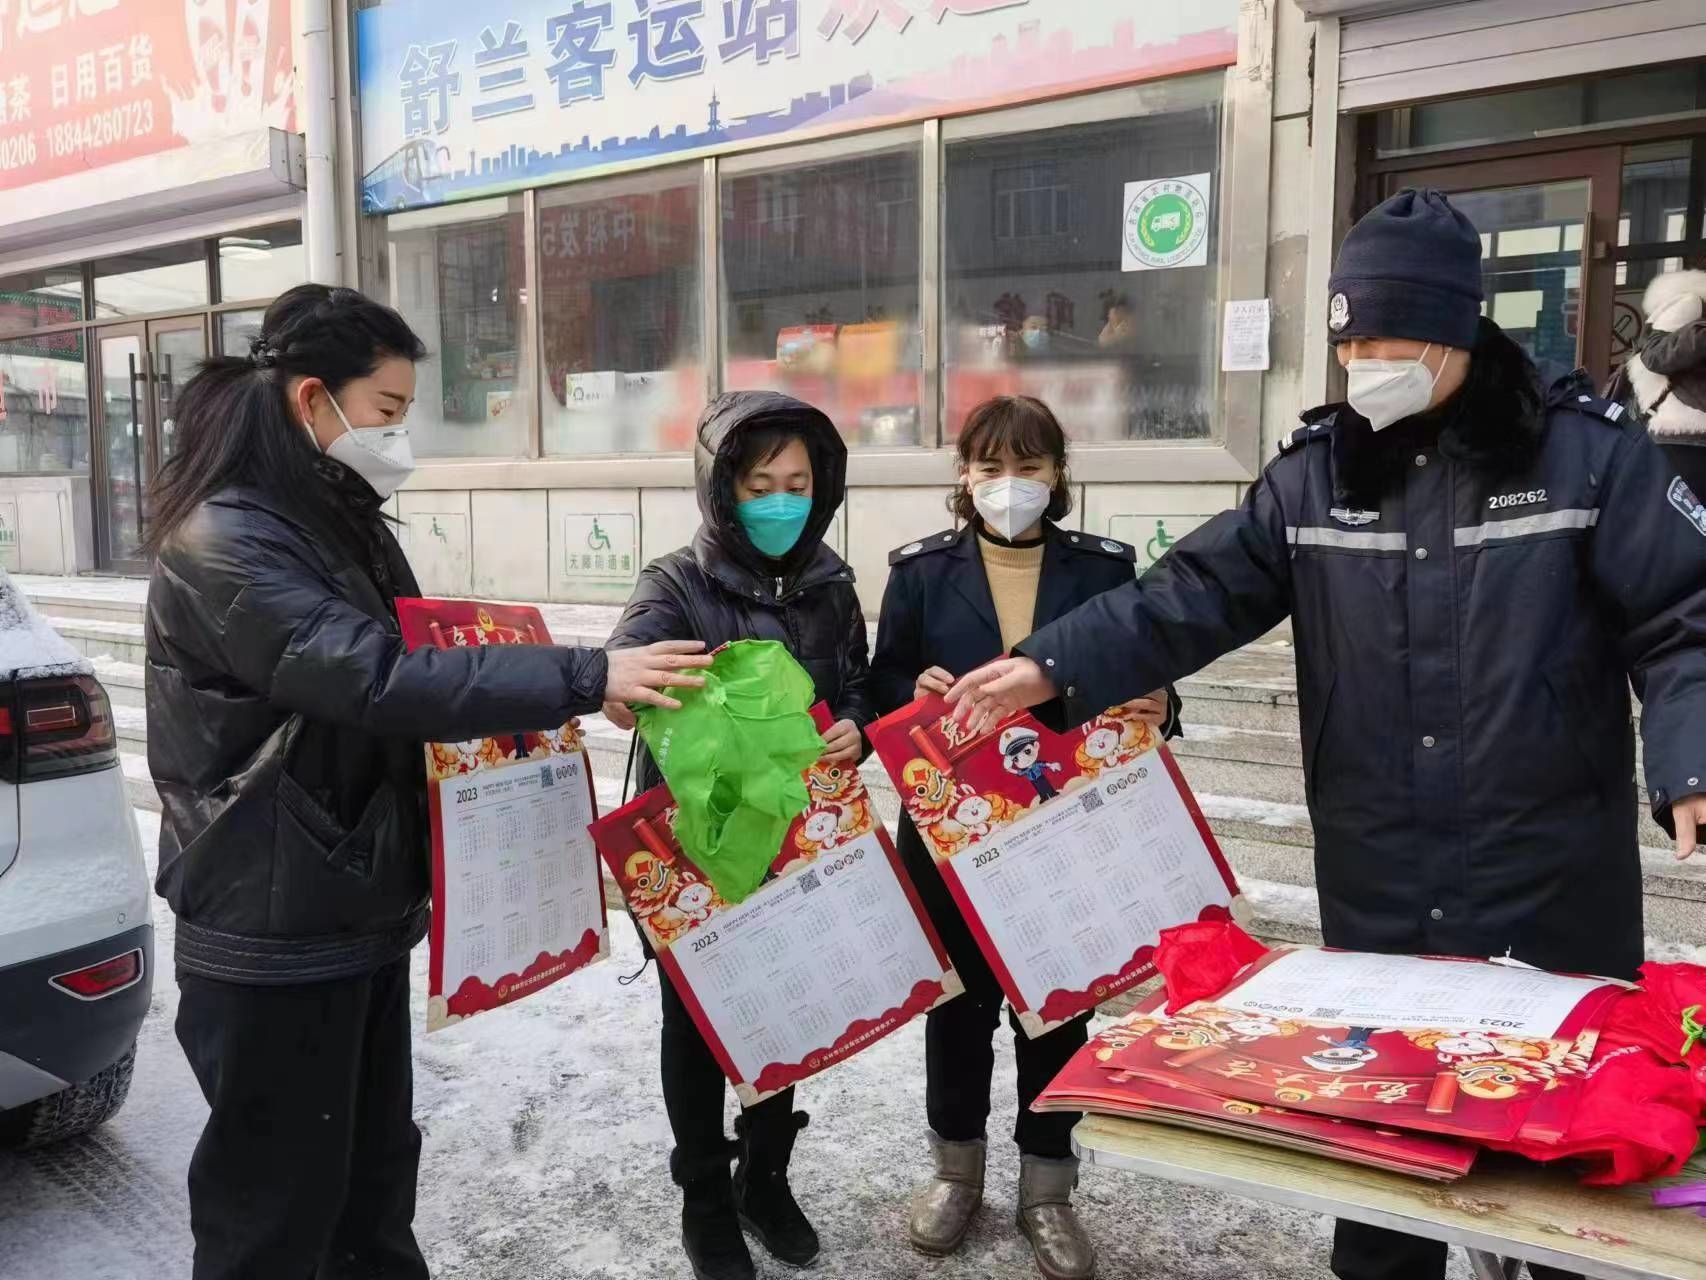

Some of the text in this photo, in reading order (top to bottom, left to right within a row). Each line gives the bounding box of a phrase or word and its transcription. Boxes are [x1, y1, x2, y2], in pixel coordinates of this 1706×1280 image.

[50, 34, 153, 109] 日用百货
[399, 0, 1030, 139] 舒兰客运站
[0, 99, 154, 171] 0206 18844260723
[1487, 488, 1548, 510] 208262
[456, 787, 479, 804] 2023
[972, 847, 1000, 869] 2023
[691, 930, 719, 953] 2023
[1479, 1017, 1525, 1030] 2023
